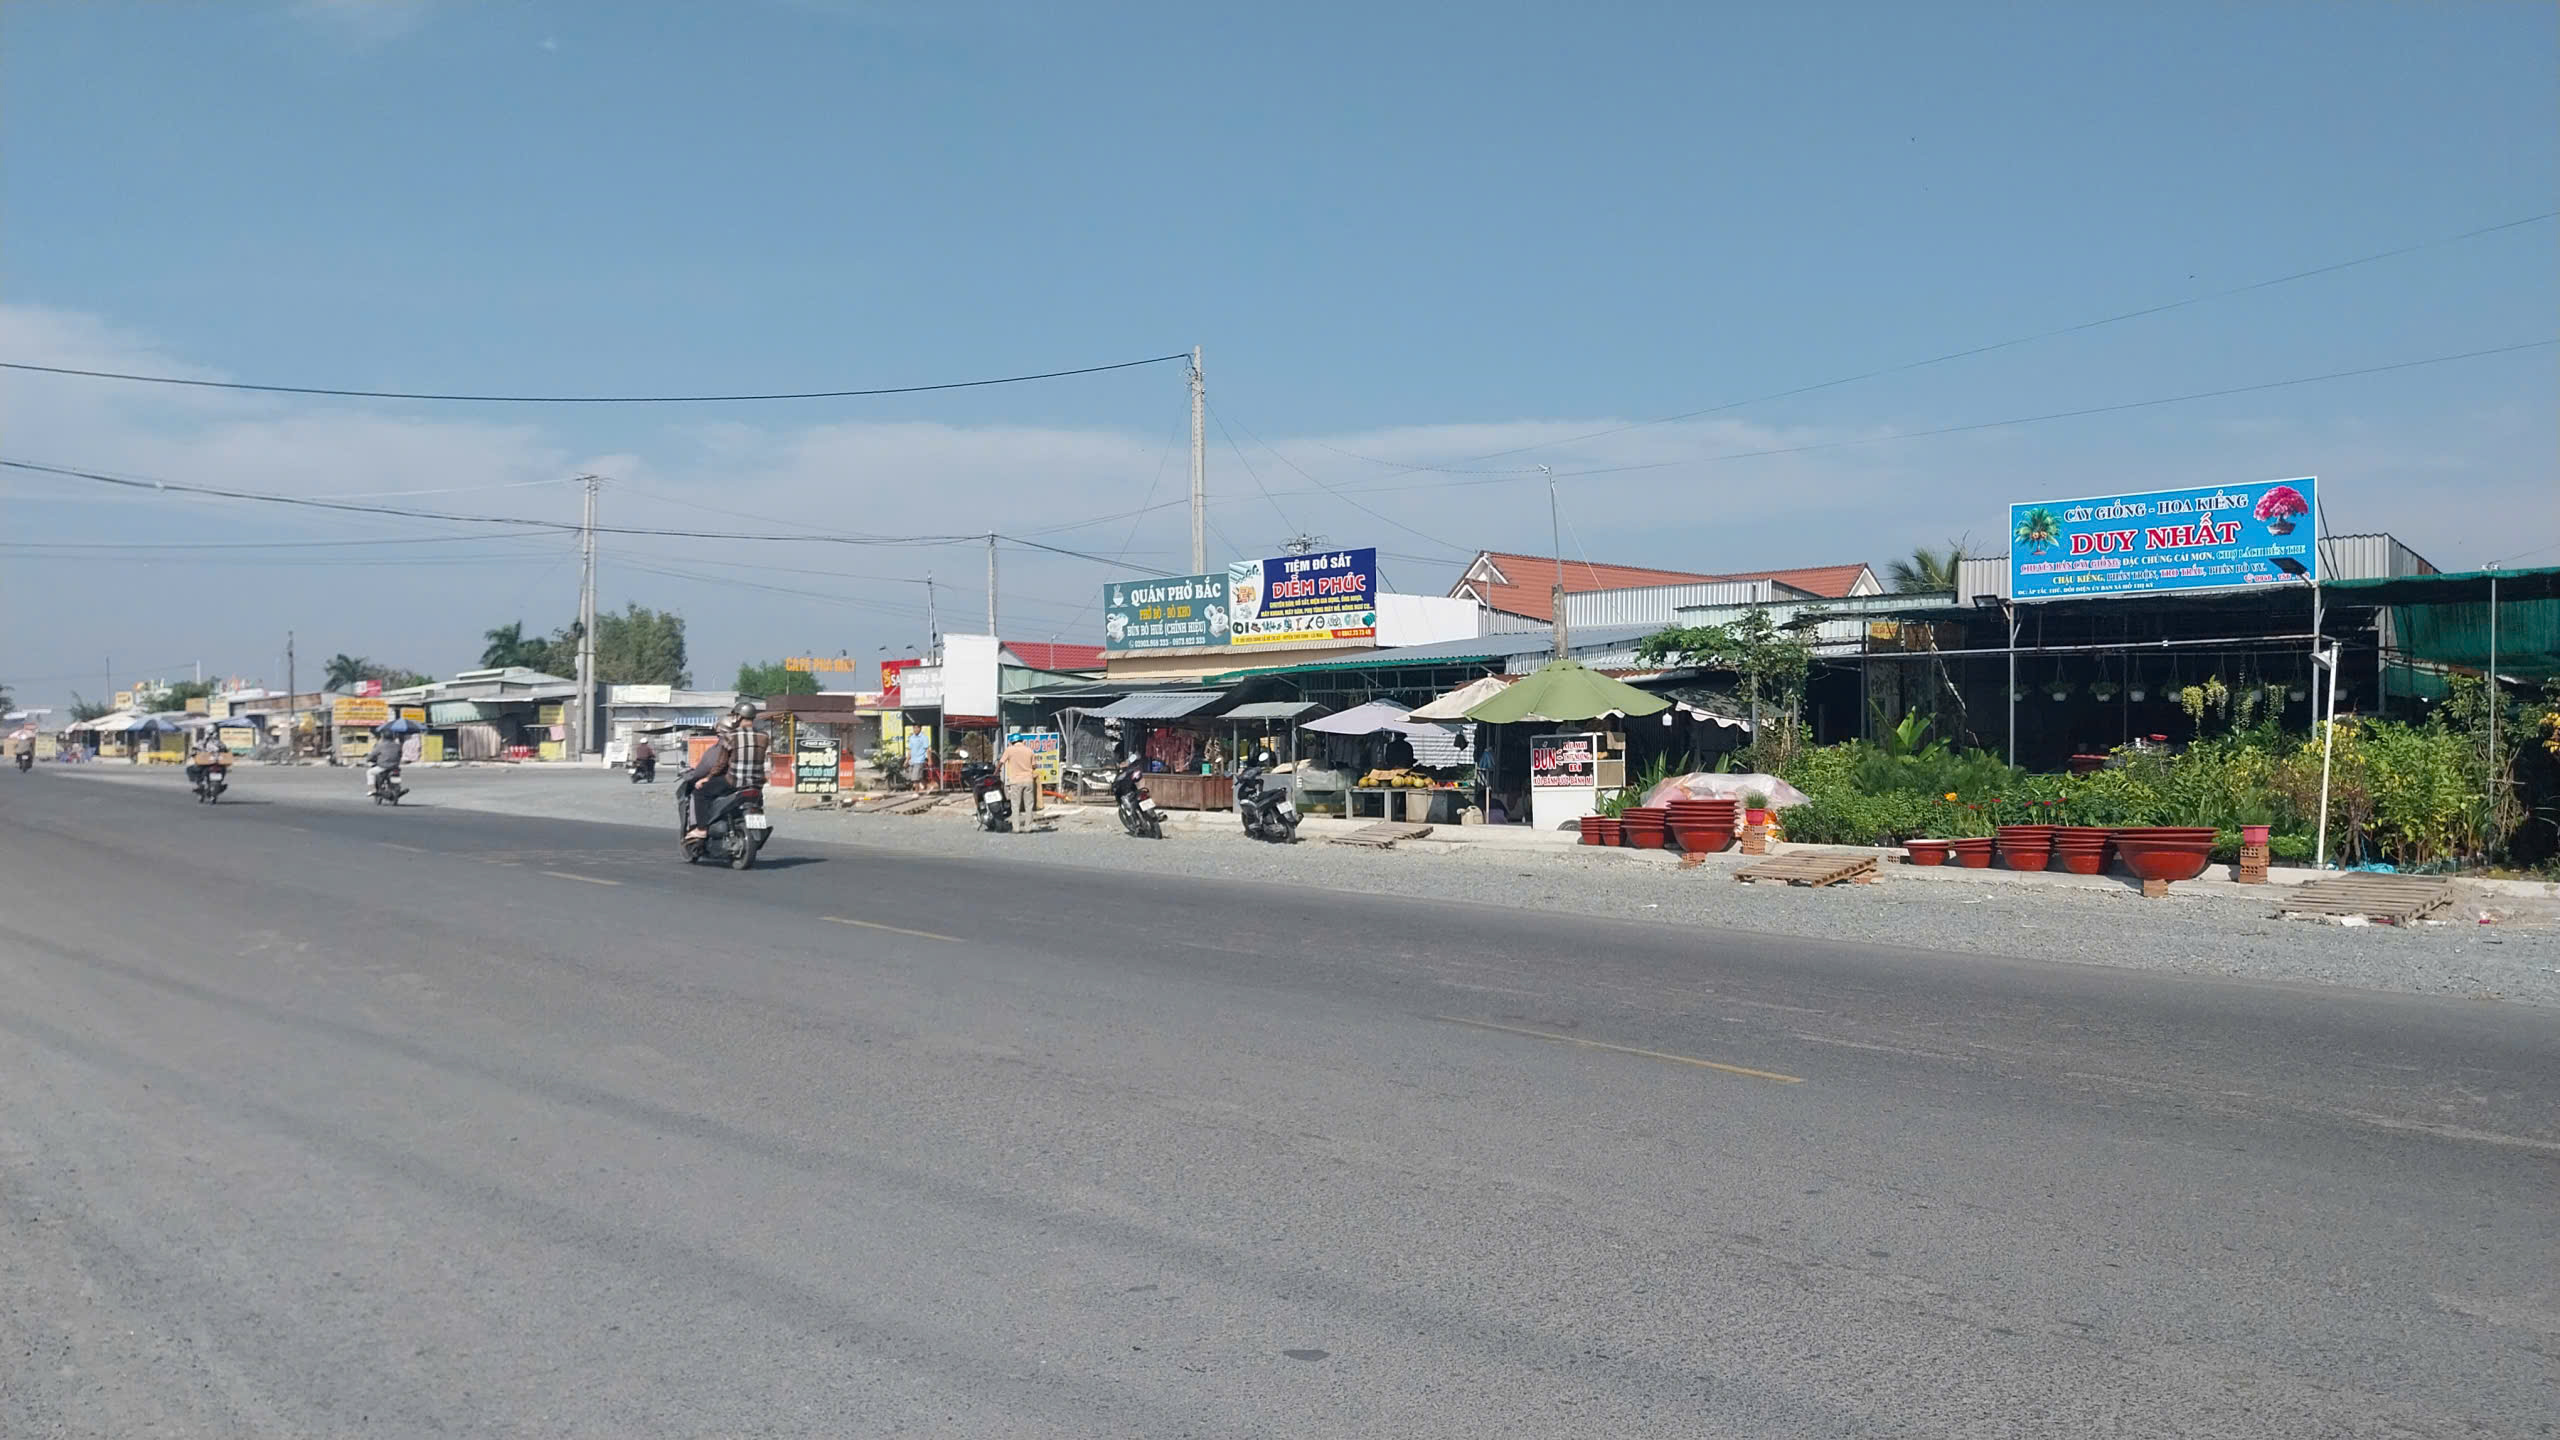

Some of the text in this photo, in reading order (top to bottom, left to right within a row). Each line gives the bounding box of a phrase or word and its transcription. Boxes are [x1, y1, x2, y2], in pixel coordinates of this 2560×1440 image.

[2064, 505, 2093, 523] CÂY
[2095, 498, 2146, 520] GIỐNG
[2157, 499, 2193, 515] HOA
[2195, 489, 2248, 511] KIỂNG
[2070, 512, 2241, 555] DUY NHẤT
[1284, 556, 1310, 574] TIỆM
[1330, 552, 1352, 568] SẮT
[2073, 559, 2090, 570] CÂY
[2123, 556, 2139, 568] ĐẶC
[2286, 545, 2306, 555] TRE
[1272, 572, 1366, 599] DIỄM PHÚC
[2160, 569, 2179, 578] TRO
[1131, 576, 1221, 607] QUÁN PHỞ BẮC
[1150, 619, 1164, 635] HUẾ
[1533, 741, 1556, 770] BÚN
